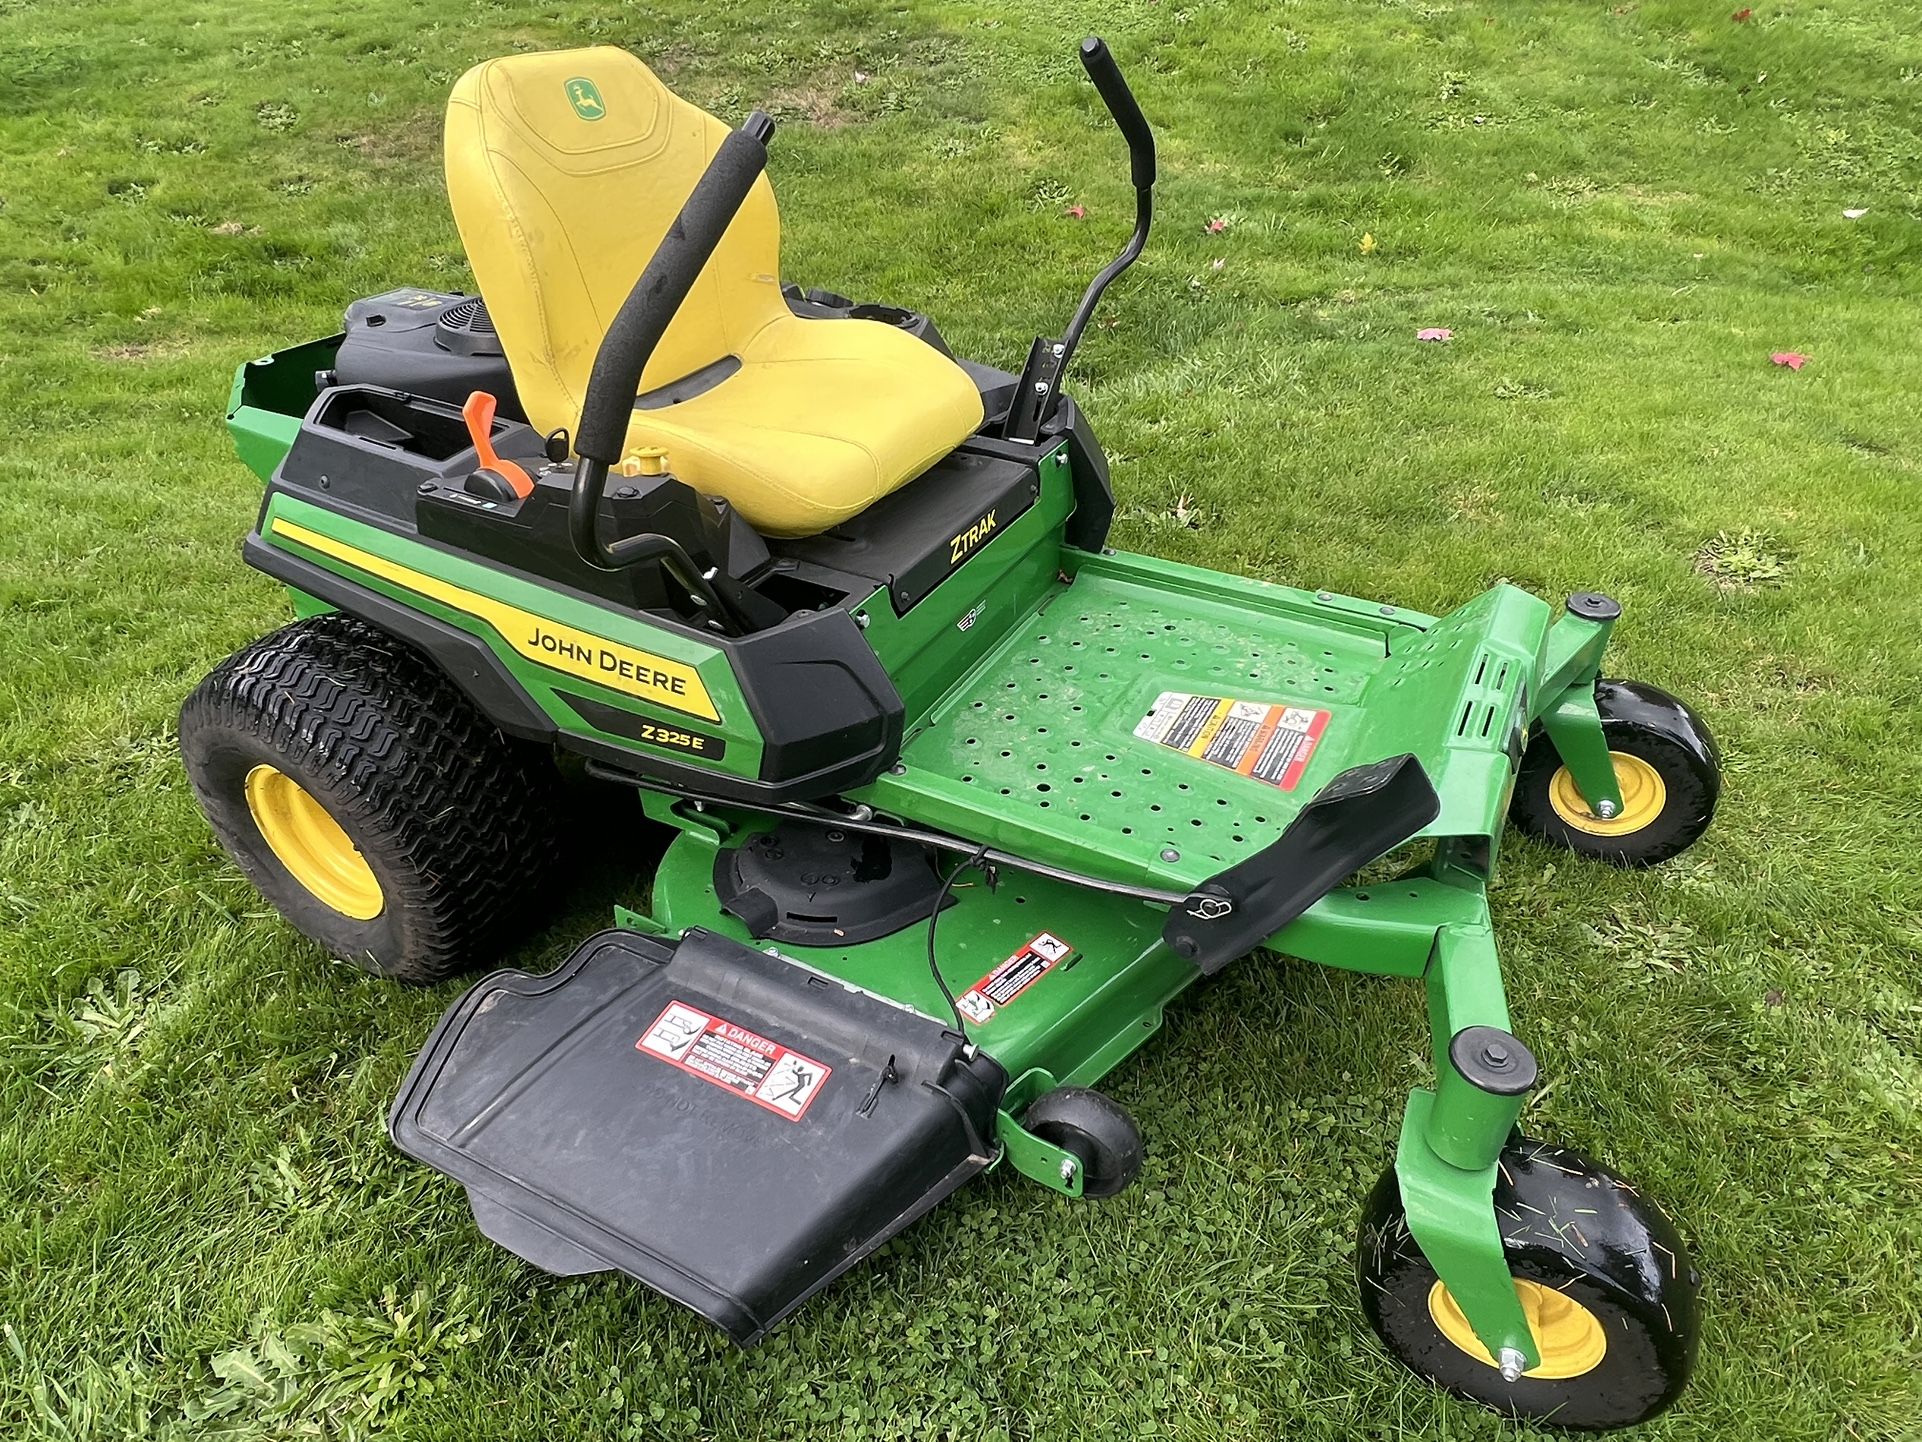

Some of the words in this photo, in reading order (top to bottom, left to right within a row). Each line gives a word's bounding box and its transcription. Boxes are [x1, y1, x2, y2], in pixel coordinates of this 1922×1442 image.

[950, 509, 996, 564] ZTRAK
[528, 627, 592, 666] JOHN
[599, 649, 687, 696] DEERE
[727, 1028, 775, 1055] DANGER
